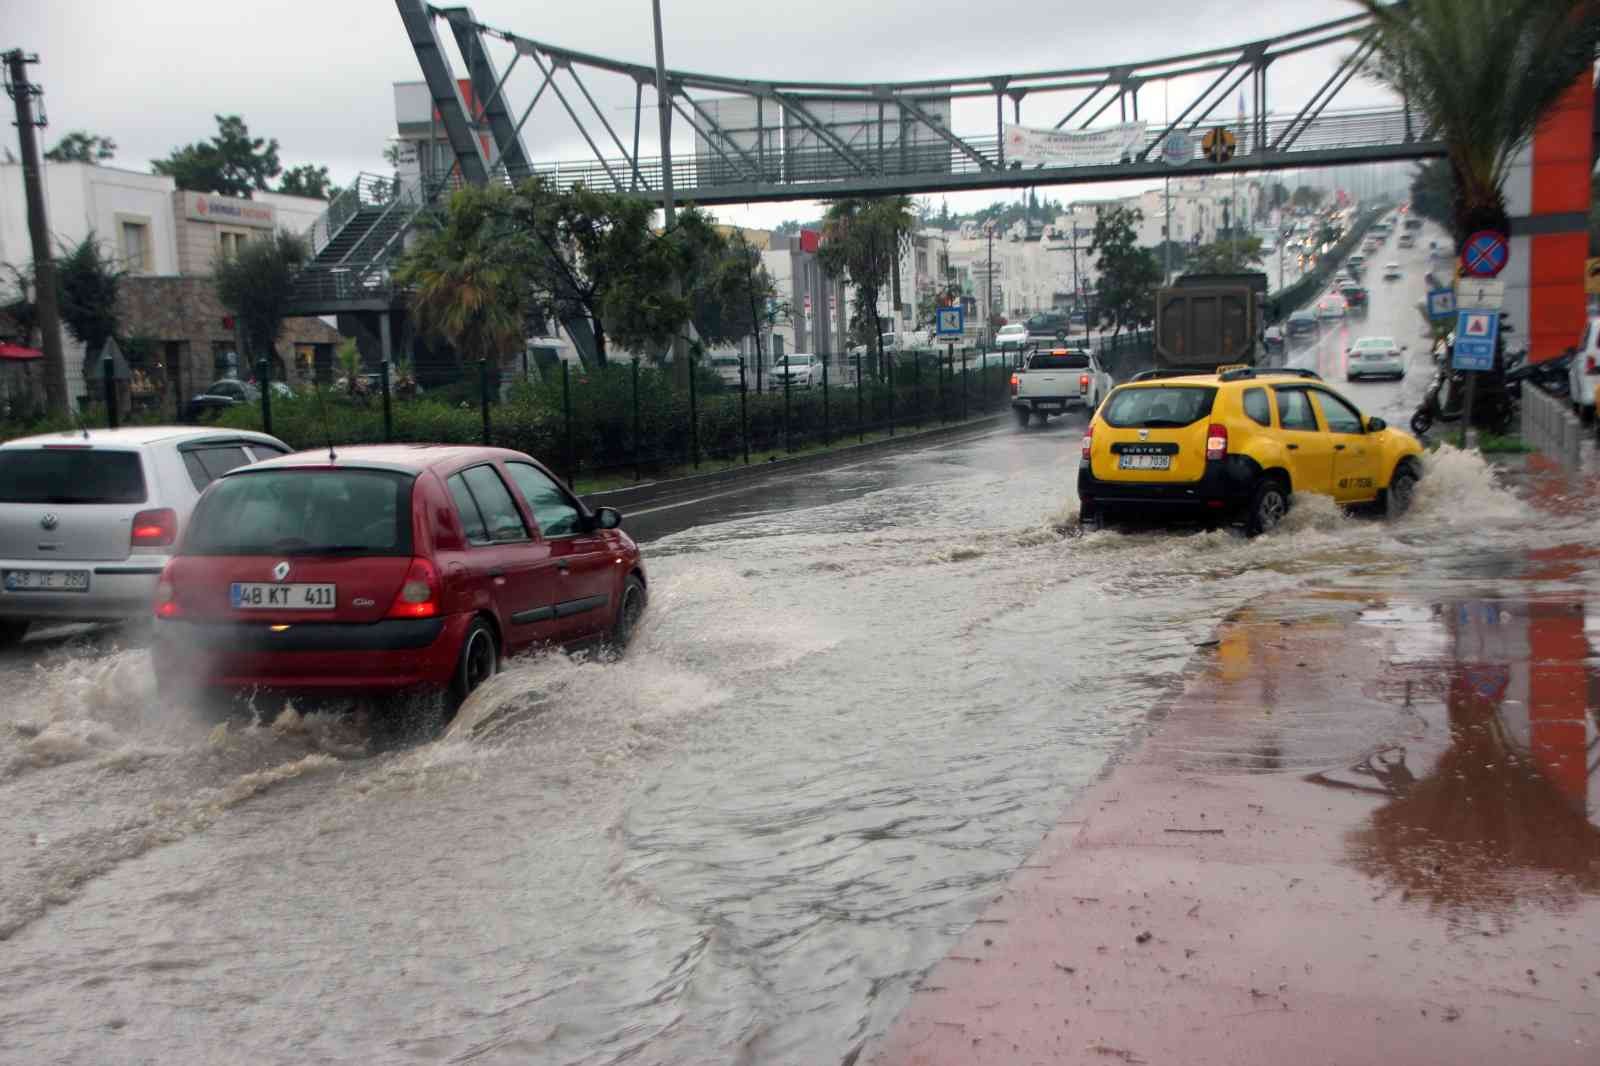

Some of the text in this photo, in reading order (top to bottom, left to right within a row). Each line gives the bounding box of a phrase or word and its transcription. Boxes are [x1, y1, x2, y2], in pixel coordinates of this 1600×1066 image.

[240, 588, 331, 605] 48 KT 411
